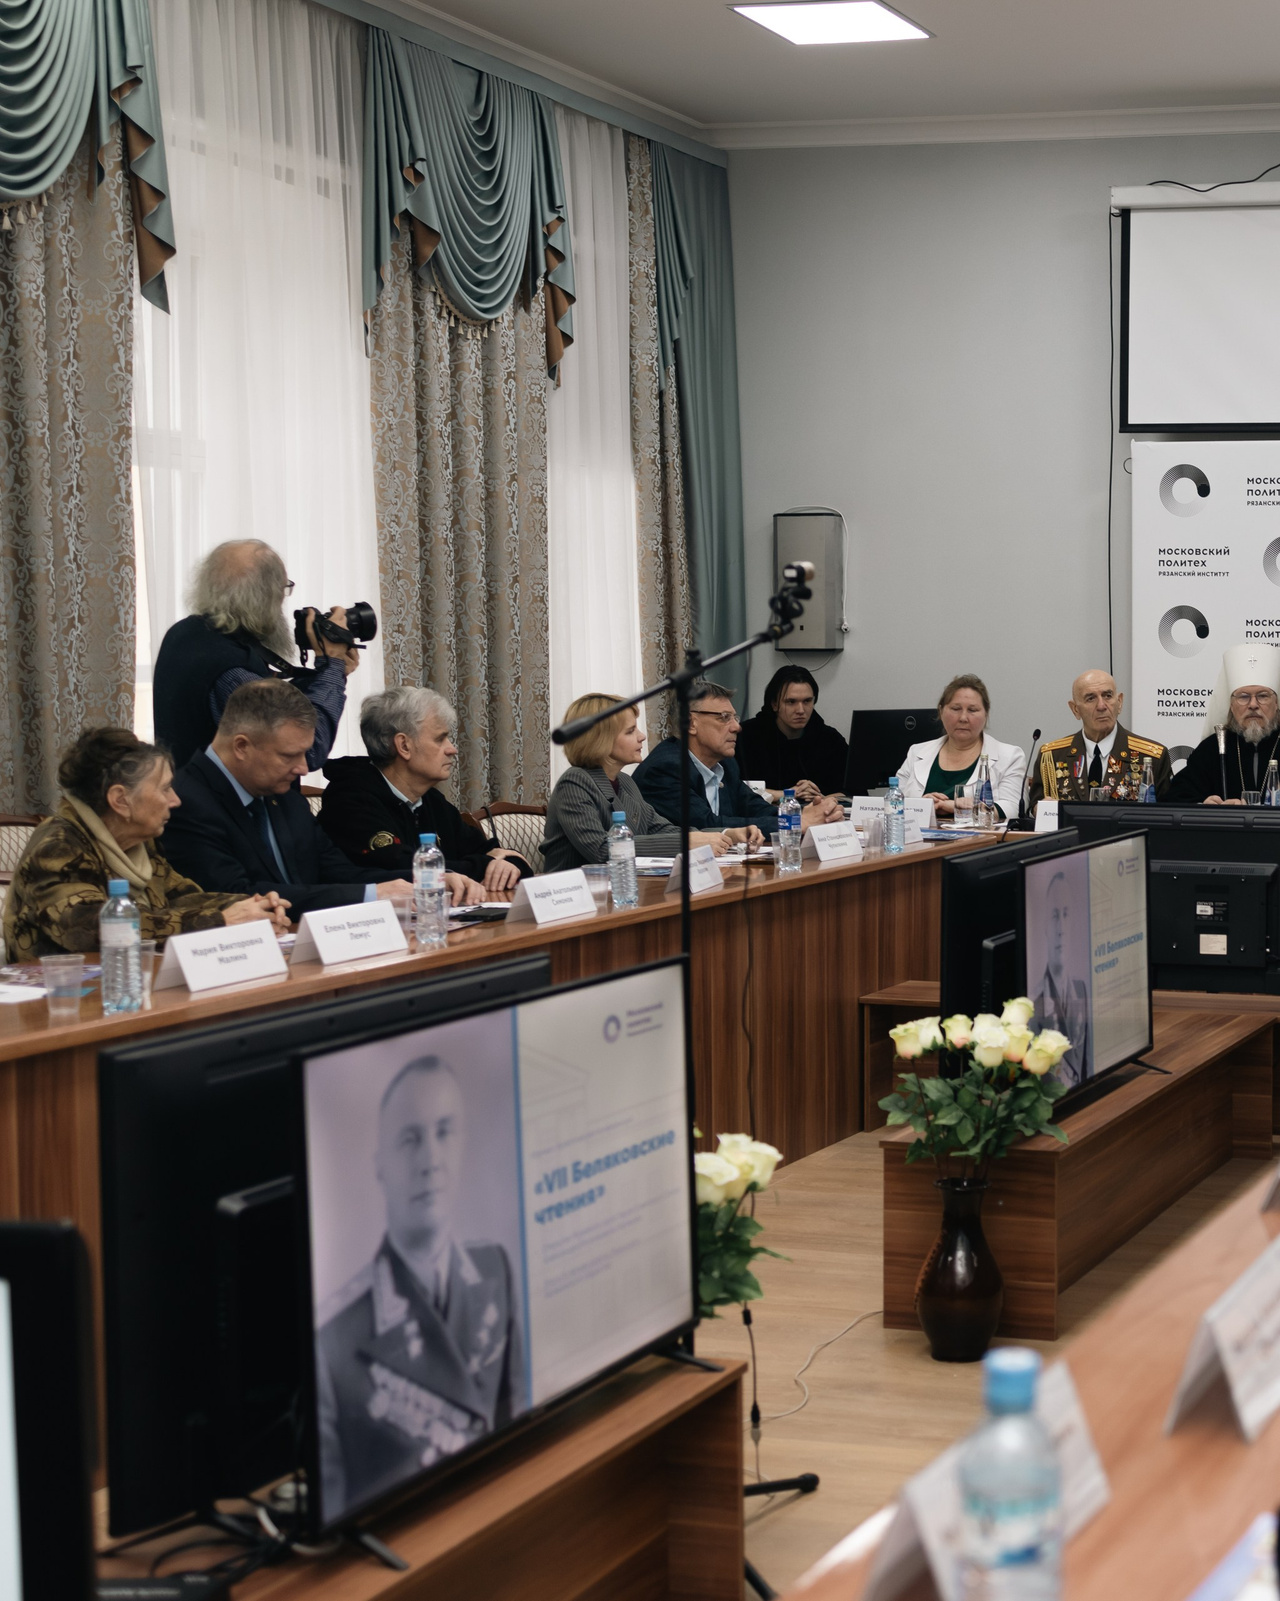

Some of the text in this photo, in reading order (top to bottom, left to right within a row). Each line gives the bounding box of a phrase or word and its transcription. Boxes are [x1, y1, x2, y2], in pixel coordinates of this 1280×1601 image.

[1158, 569, 1230, 578] РЯЗАНСКИЙ ИНСТИТУТ
[1156, 688, 1214, 697] московск
[1156, 710, 1195, 718] РЯЗАНСКИЙ
[533, 889, 553, 900] Андрей
[323, 916, 387, 934] Елена Викторовна
[191, 936, 265, 959] Мария Викторовна
[217, 952, 249, 965] Малина
